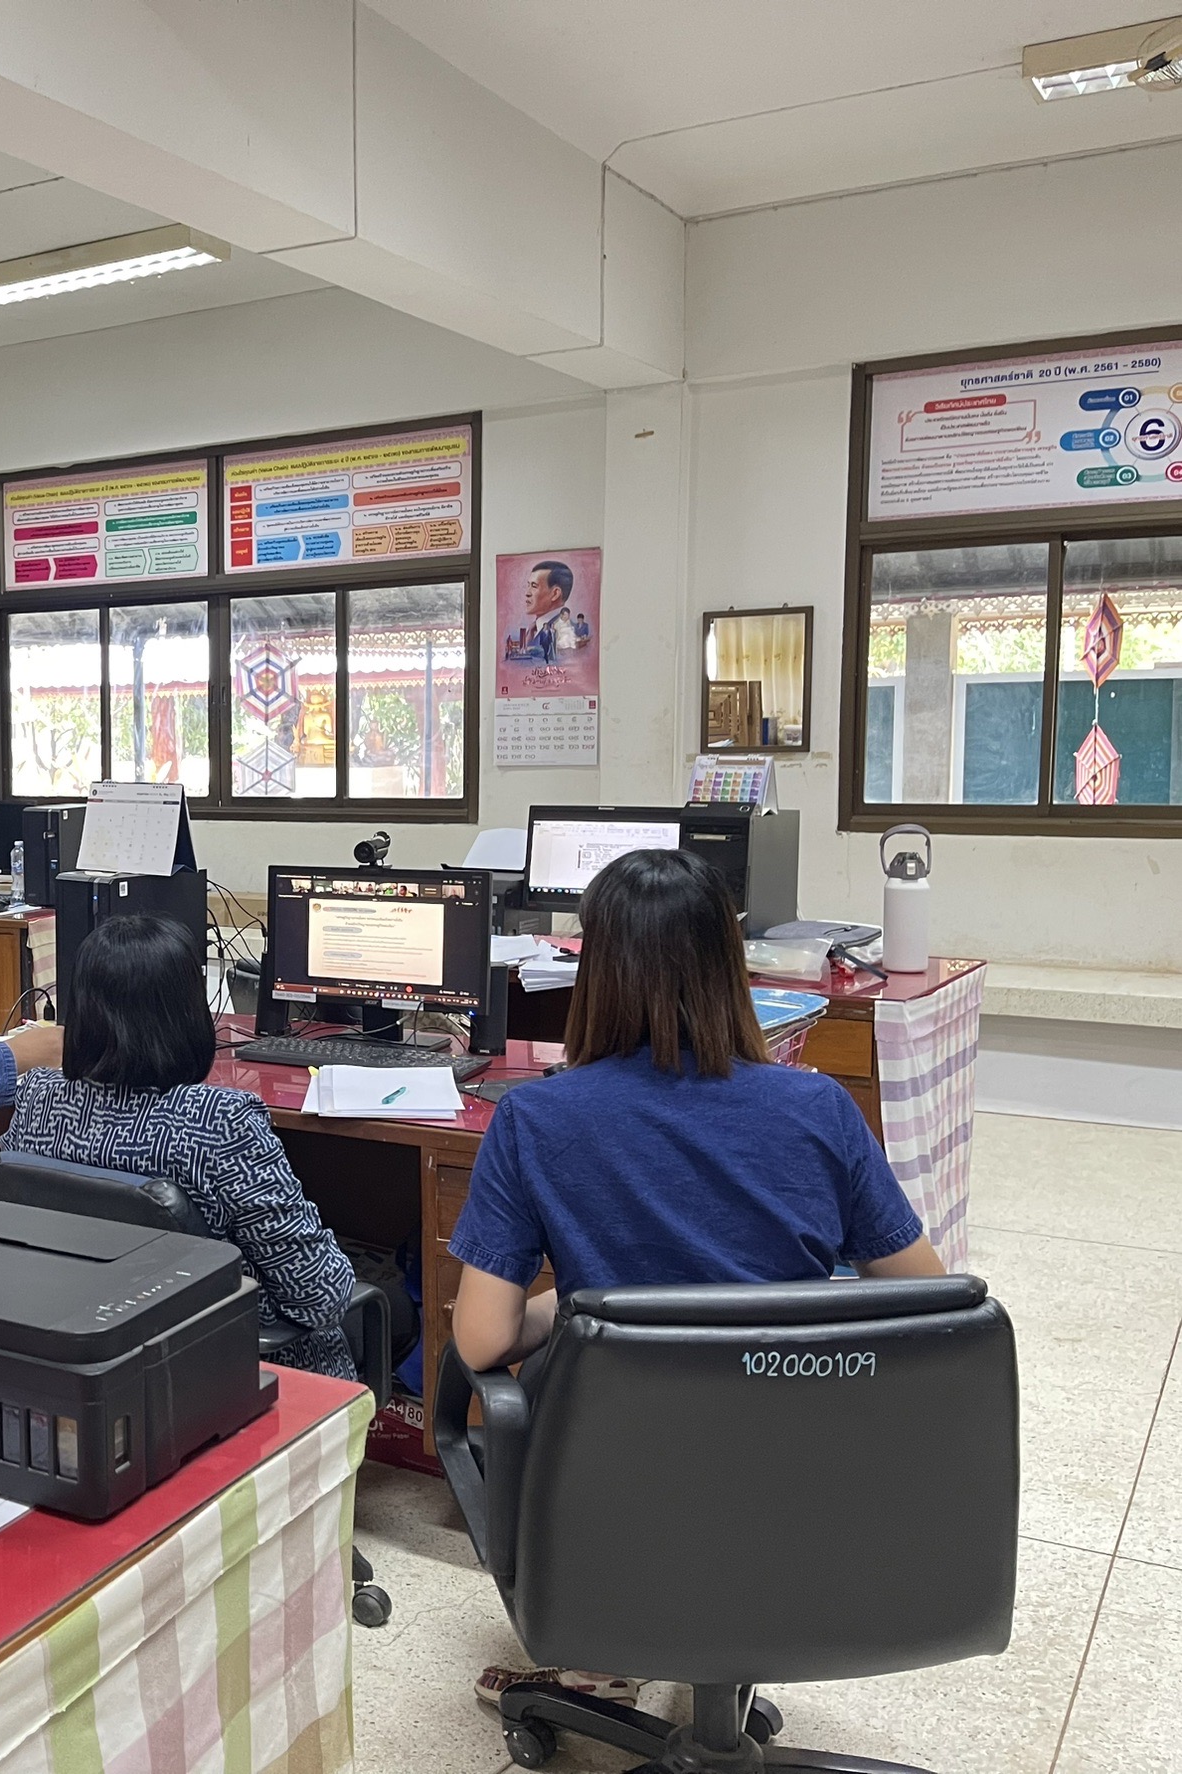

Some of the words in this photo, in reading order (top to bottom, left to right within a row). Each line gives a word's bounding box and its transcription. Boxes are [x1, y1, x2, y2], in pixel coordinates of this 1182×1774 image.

[1039, 369, 1052, 378] 20
[1054, 366, 1062, 376] ปี
[1064, 365, 1091, 377] (พ.ศ.
[1094, 362, 1118, 372] 2561
[1131, 357, 1161, 369] 2580)
[742, 1351, 876, 1377] 102000109
[386, 1399, 405, 1415] A4
[407, 1407, 423, 1422] 80
